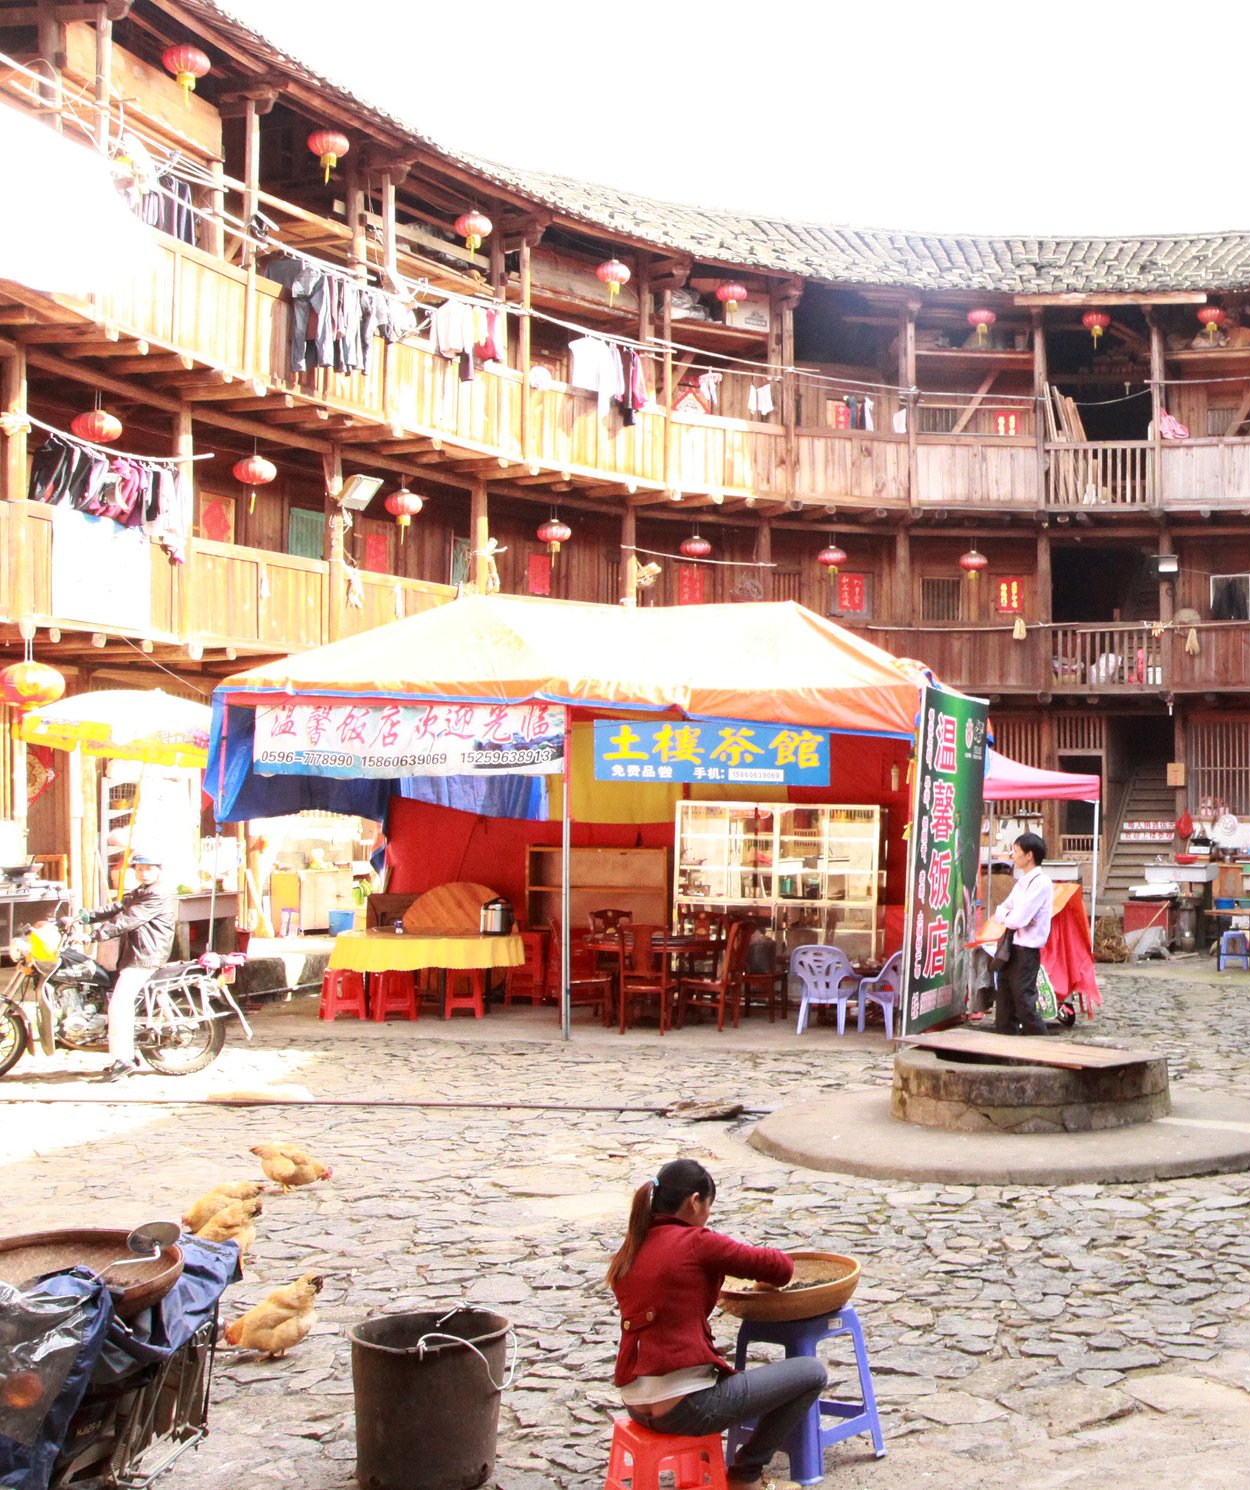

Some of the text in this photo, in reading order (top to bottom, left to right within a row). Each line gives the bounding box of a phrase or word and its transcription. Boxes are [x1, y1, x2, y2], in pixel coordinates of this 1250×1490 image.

[271, 704, 551, 748] 温馨饭店欢迎光临
[602, 724, 825, 769] 土樓茶館
[361, 752, 448, 768] 15860639069
[460, 750, 552, 764] 15259638913
[611, 764, 673, 779] 免费品尝
[923, 711, 957, 979] 温馨饭店
